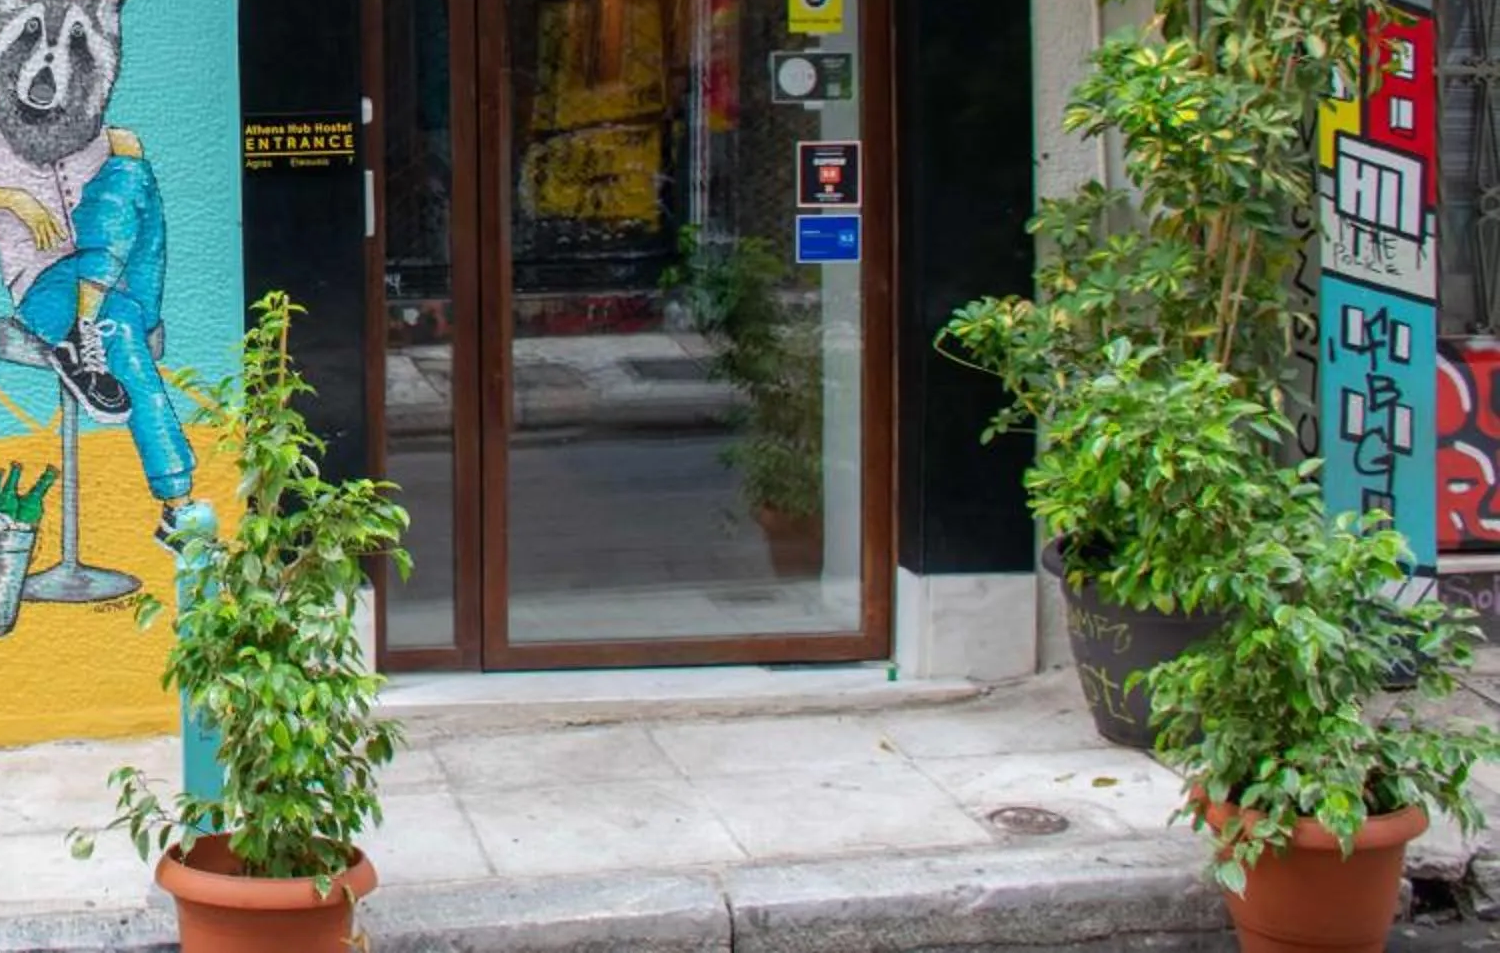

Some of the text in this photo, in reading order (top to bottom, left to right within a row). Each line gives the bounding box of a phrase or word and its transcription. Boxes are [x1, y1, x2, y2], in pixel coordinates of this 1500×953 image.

[245, 122, 353, 136] Athens Hub Hostel
[245, 134, 355, 151] ENTRANCE
